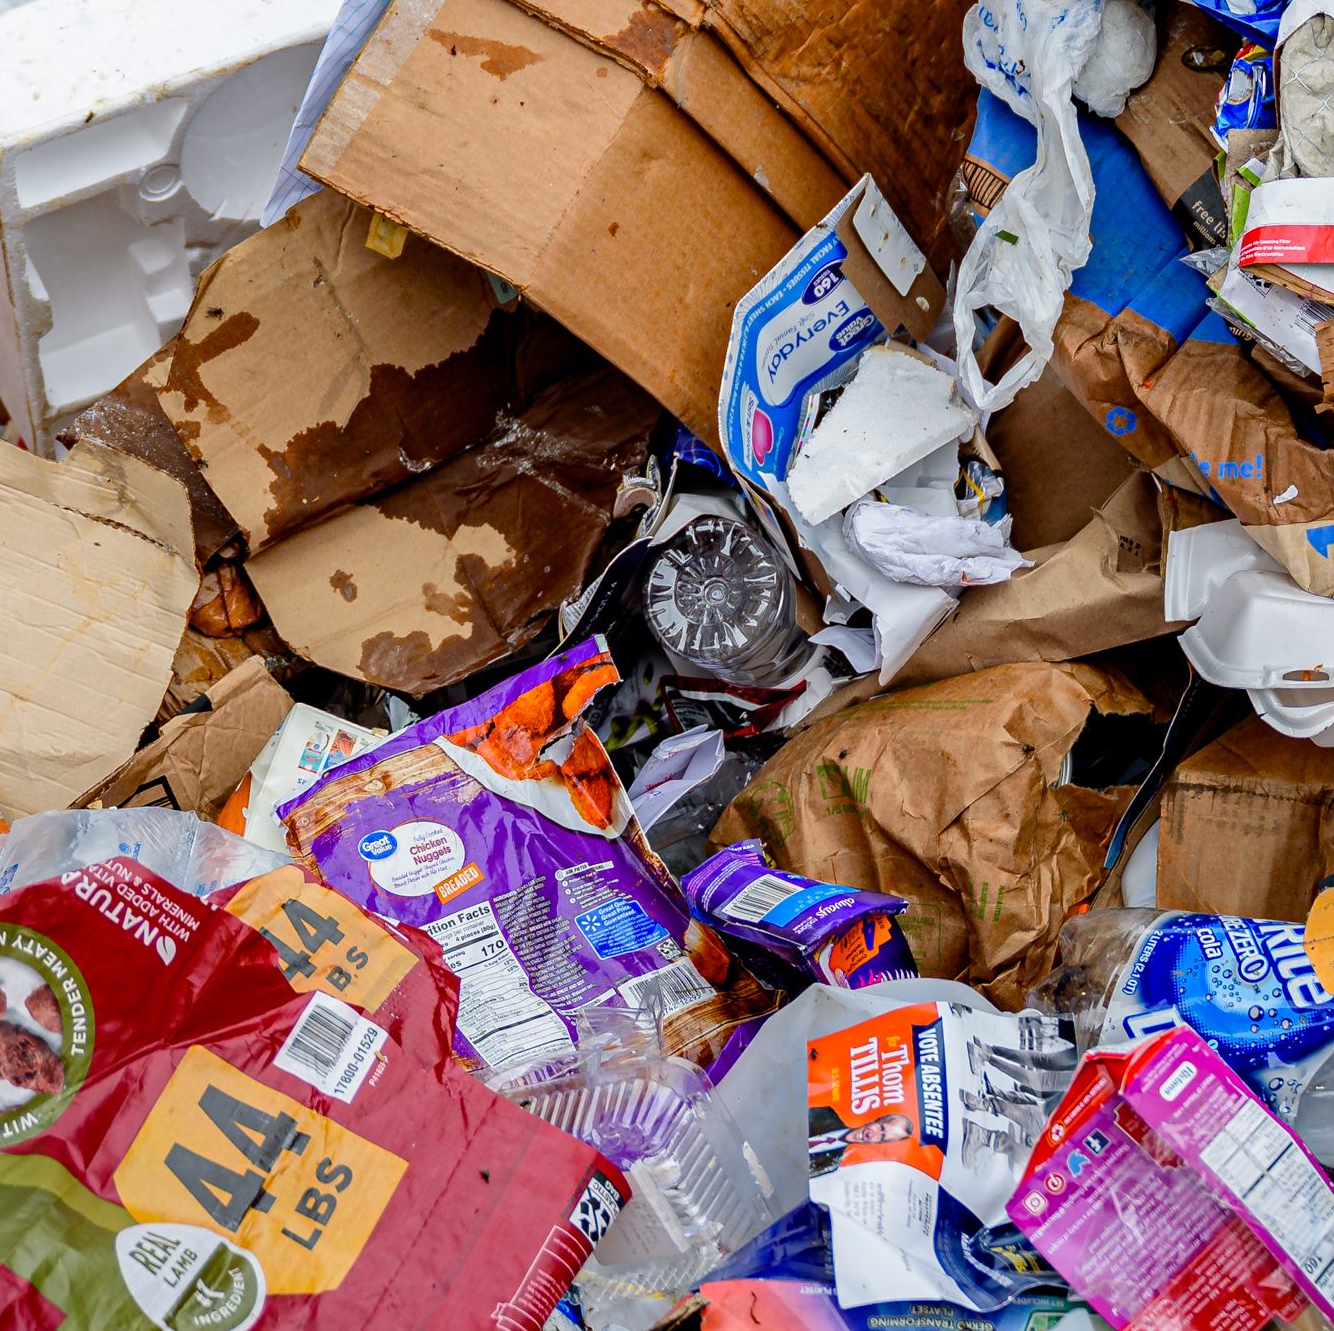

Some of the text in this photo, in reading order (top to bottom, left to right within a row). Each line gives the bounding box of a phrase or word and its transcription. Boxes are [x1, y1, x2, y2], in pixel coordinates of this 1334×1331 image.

[1192, 200, 1214, 225] free
[1193, 221, 1216, 245] millions
[744, 242, 834, 327] FACIAL TISSUES EACH SHEET
[814, 272, 839, 298] 160
[767, 300, 850, 384] Everyday
[361, 835, 390, 851] Great
[372, 843, 393, 856] Value
[409, 836, 447, 855] Chicken
[412, 847, 452, 865] Nuggets
[438, 866, 479, 899] BREADED
[61, 870, 160, 947] NATURA
[117, 883, 160, 917] ADDED
[141, 882, 201, 931] MINERALS
[457, 905, 490, 923] Facts
[816, 897, 856, 920] always
[158, 913, 191, 943] WITH
[460, 920, 485, 934] container
[461, 923, 496, 941] pieces (80g)
[604, 910, 637, 926] Guaranteed.
[11, 934, 68, 979] MEATY
[481, 939, 504, 957] 170
[1139, 937, 1159, 963] LITERS
[1196, 928, 1222, 959] cola
[1229, 928, 1268, 984] ZERO
[324, 944, 369, 993] BS
[63, 977, 88, 1057] TENDER
[333, 1025, 381, 1098] 17800-01529
[849, 1036, 881, 1115] TILLIS
[881, 1043, 911, 1106] Thom
[917, 1027, 945, 1139] VOTE ABSENTEE
[163, 1083, 312, 1233] 44
[281, 1155, 354, 1252] LBS
[127, 1230, 182, 1276] REAL
[163, 1247, 200, 1290] LAMB
[192, 1266, 244, 1328] INGREDIENT
[800, 1285, 832, 1296] PLAYSET
[869, 1316, 955, 1330] TRANSFORMING
[909, 1304, 954, 1317] PLAYSET
